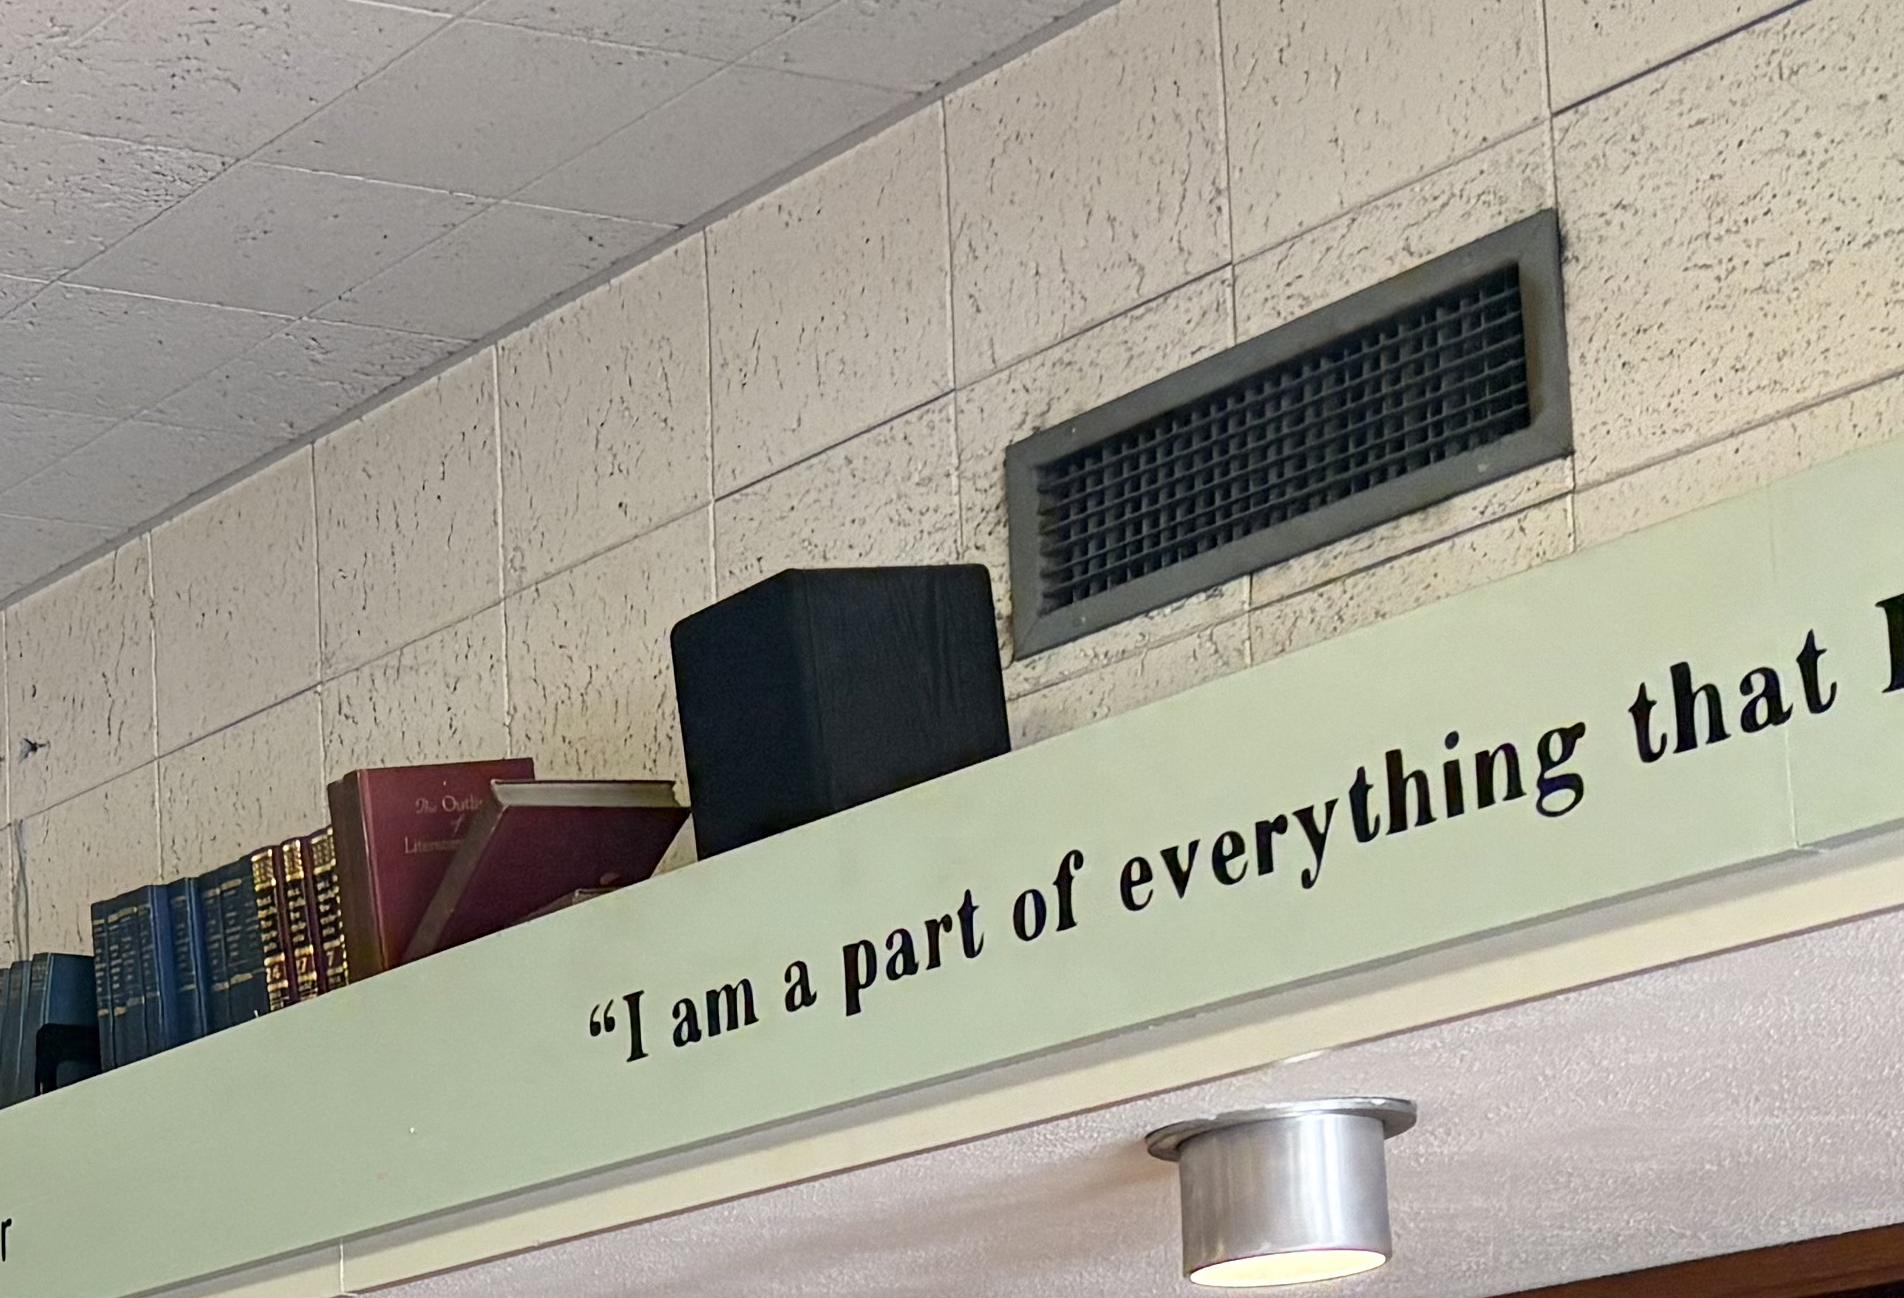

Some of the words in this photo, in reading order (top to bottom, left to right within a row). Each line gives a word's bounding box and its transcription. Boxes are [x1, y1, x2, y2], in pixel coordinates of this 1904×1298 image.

[669, 970, 759, 1052] am
[782, 951, 818, 1013] a
[840, 890, 985, 1018] part
[1011, 850, 1084, 943] of
[1116, 716, 1588, 893] everything
[1627, 627, 1840, 765] that
